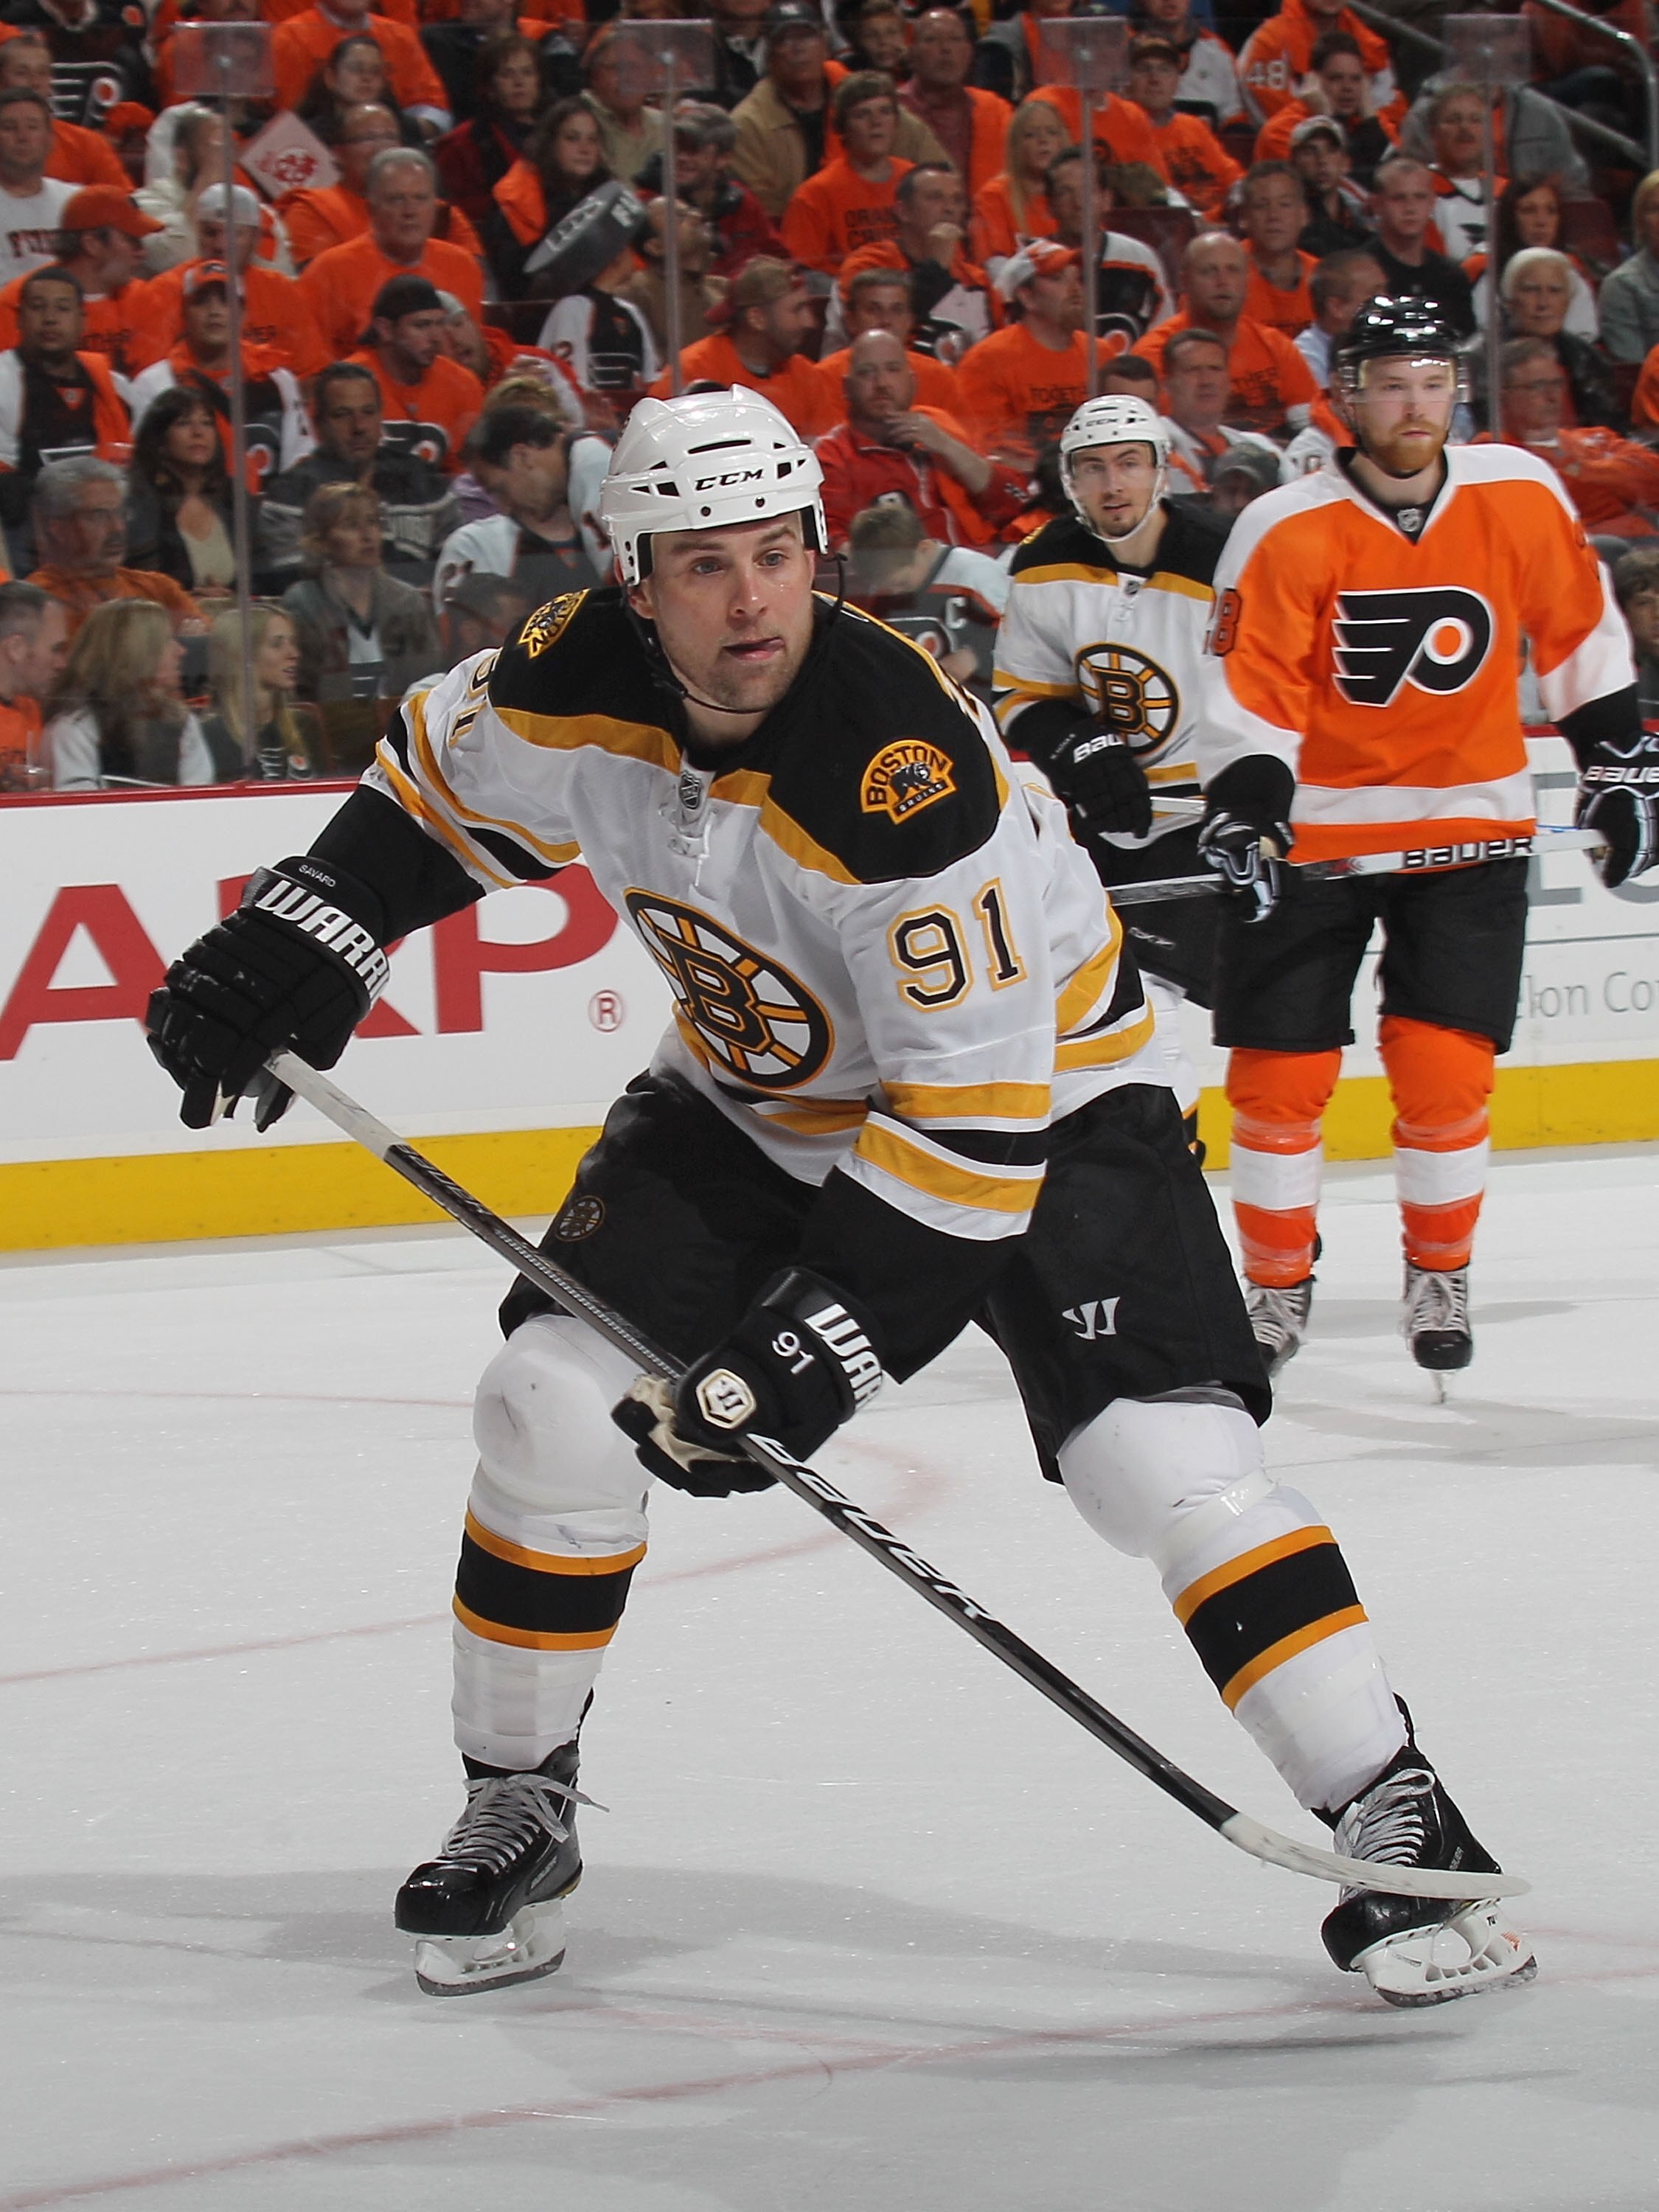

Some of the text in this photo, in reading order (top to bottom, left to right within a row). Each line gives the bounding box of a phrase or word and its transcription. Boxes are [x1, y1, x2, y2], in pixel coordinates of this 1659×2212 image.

[1085, 417, 1119, 427] CCM
[695, 468, 764, 491] CCM
[945, 597, 967, 629] C
[867, 745, 947, 805] BOSTON
[898, 782, 945, 813] BRUINS
[1403, 836, 1532, 869] BAUER
[299, 864, 335, 887] SAVARD
[887, 877, 1028, 1014] 91
[772, 1332, 815, 1374] 91
[746, 1433, 993, 1619] BAUER
